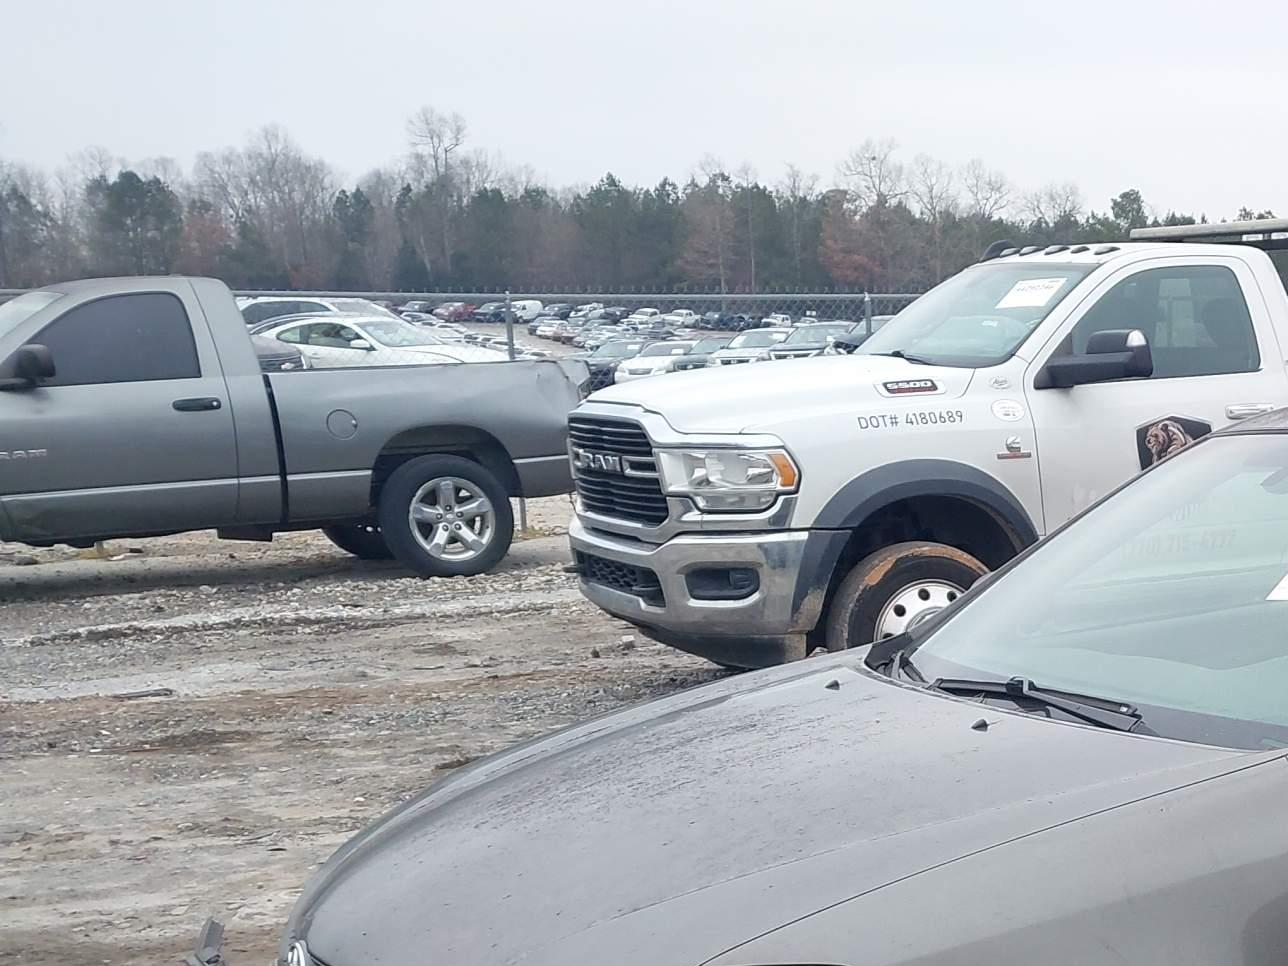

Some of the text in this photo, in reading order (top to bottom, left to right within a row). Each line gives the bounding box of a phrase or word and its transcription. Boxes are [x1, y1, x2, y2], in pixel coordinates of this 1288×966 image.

[886, 380, 932, 390] 5500
[857, 410, 963, 430] DOT# 4180689
[580, 452, 621, 471] RAM
